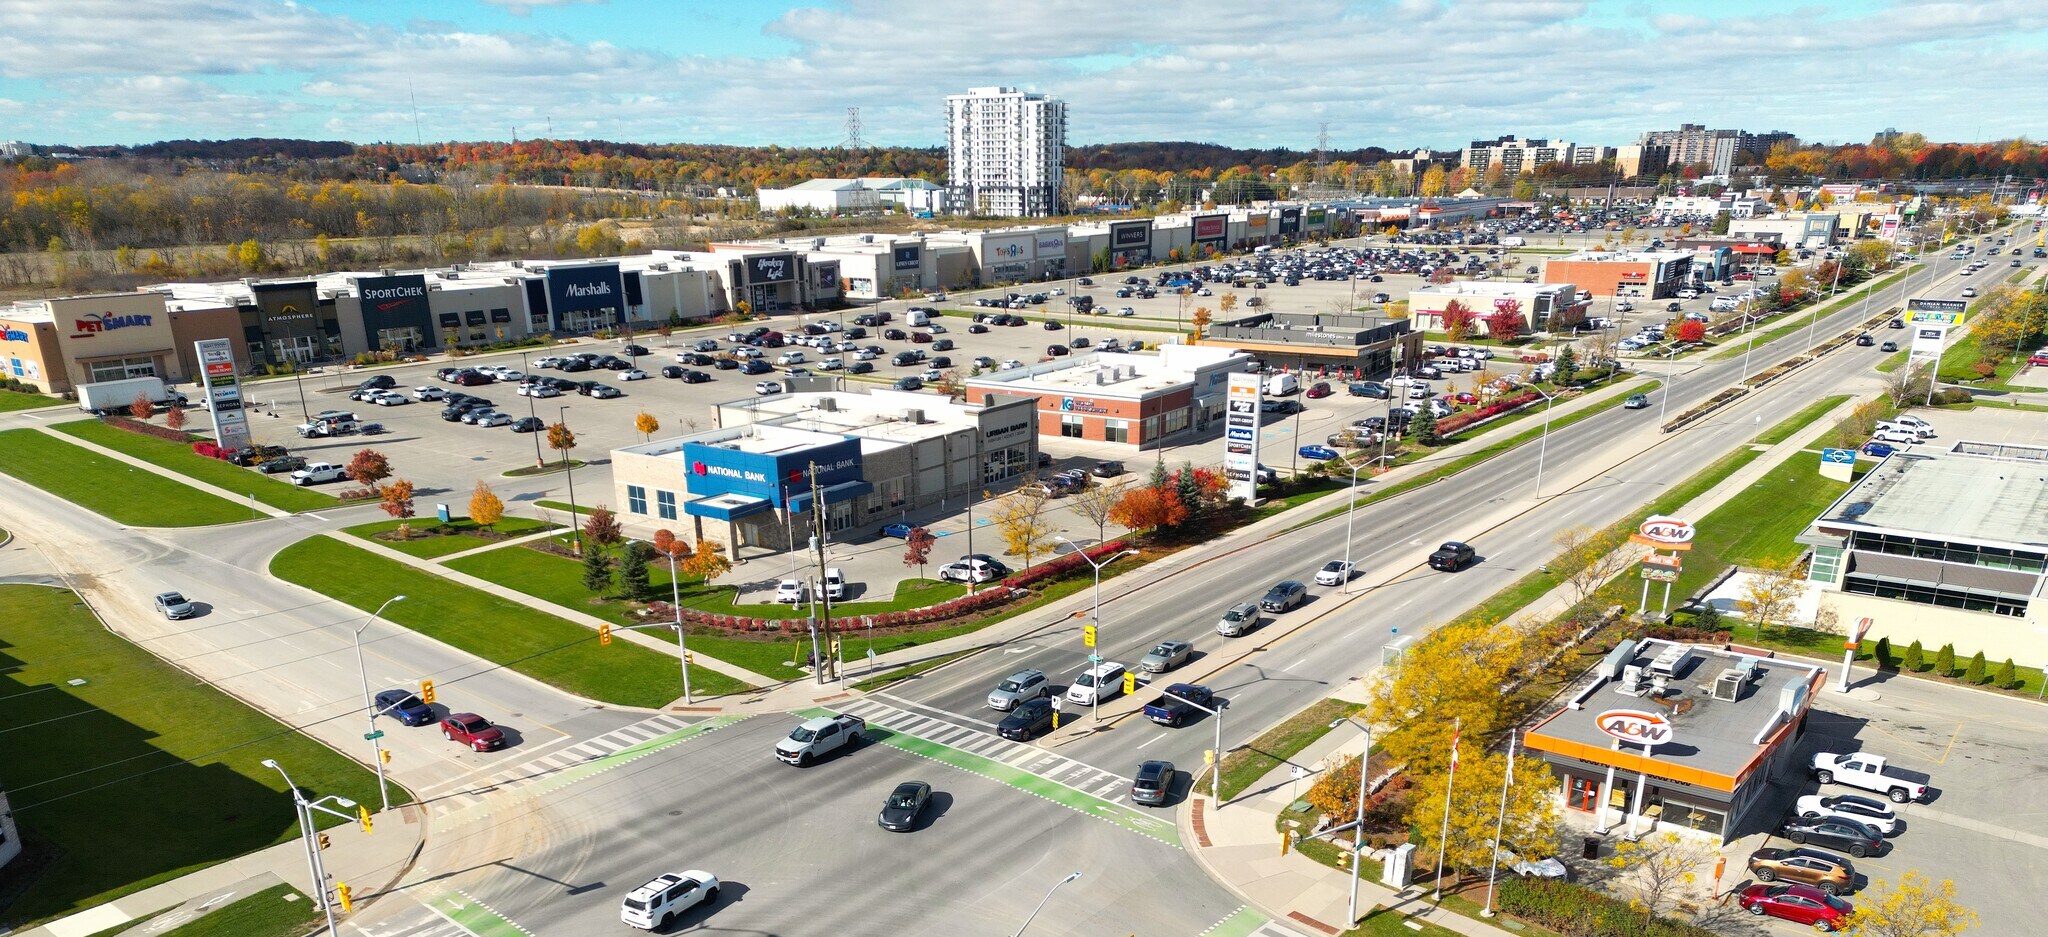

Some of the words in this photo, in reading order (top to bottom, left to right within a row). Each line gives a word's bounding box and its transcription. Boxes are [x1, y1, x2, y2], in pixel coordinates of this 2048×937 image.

[757, 258, 785, 271] Hockey
[766, 270, 783, 280] Life
[566, 281, 611, 298] Marshalls
[76, 314, 152, 332] PETSMART
[268, 313, 313, 322] ATMOSPHERE
[986, 427, 1009, 437] URBAN
[1010, 422, 1027, 431] BARN
[1230, 430, 1251, 438] Marshalls
[836, 458, 854, 470] BANK
[707, 465, 742, 479] NATIONAL
[745, 471, 766, 483] BANK
[1648, 526, 1690, 538] A&W
[1606, 720, 1667, 740] A&W
